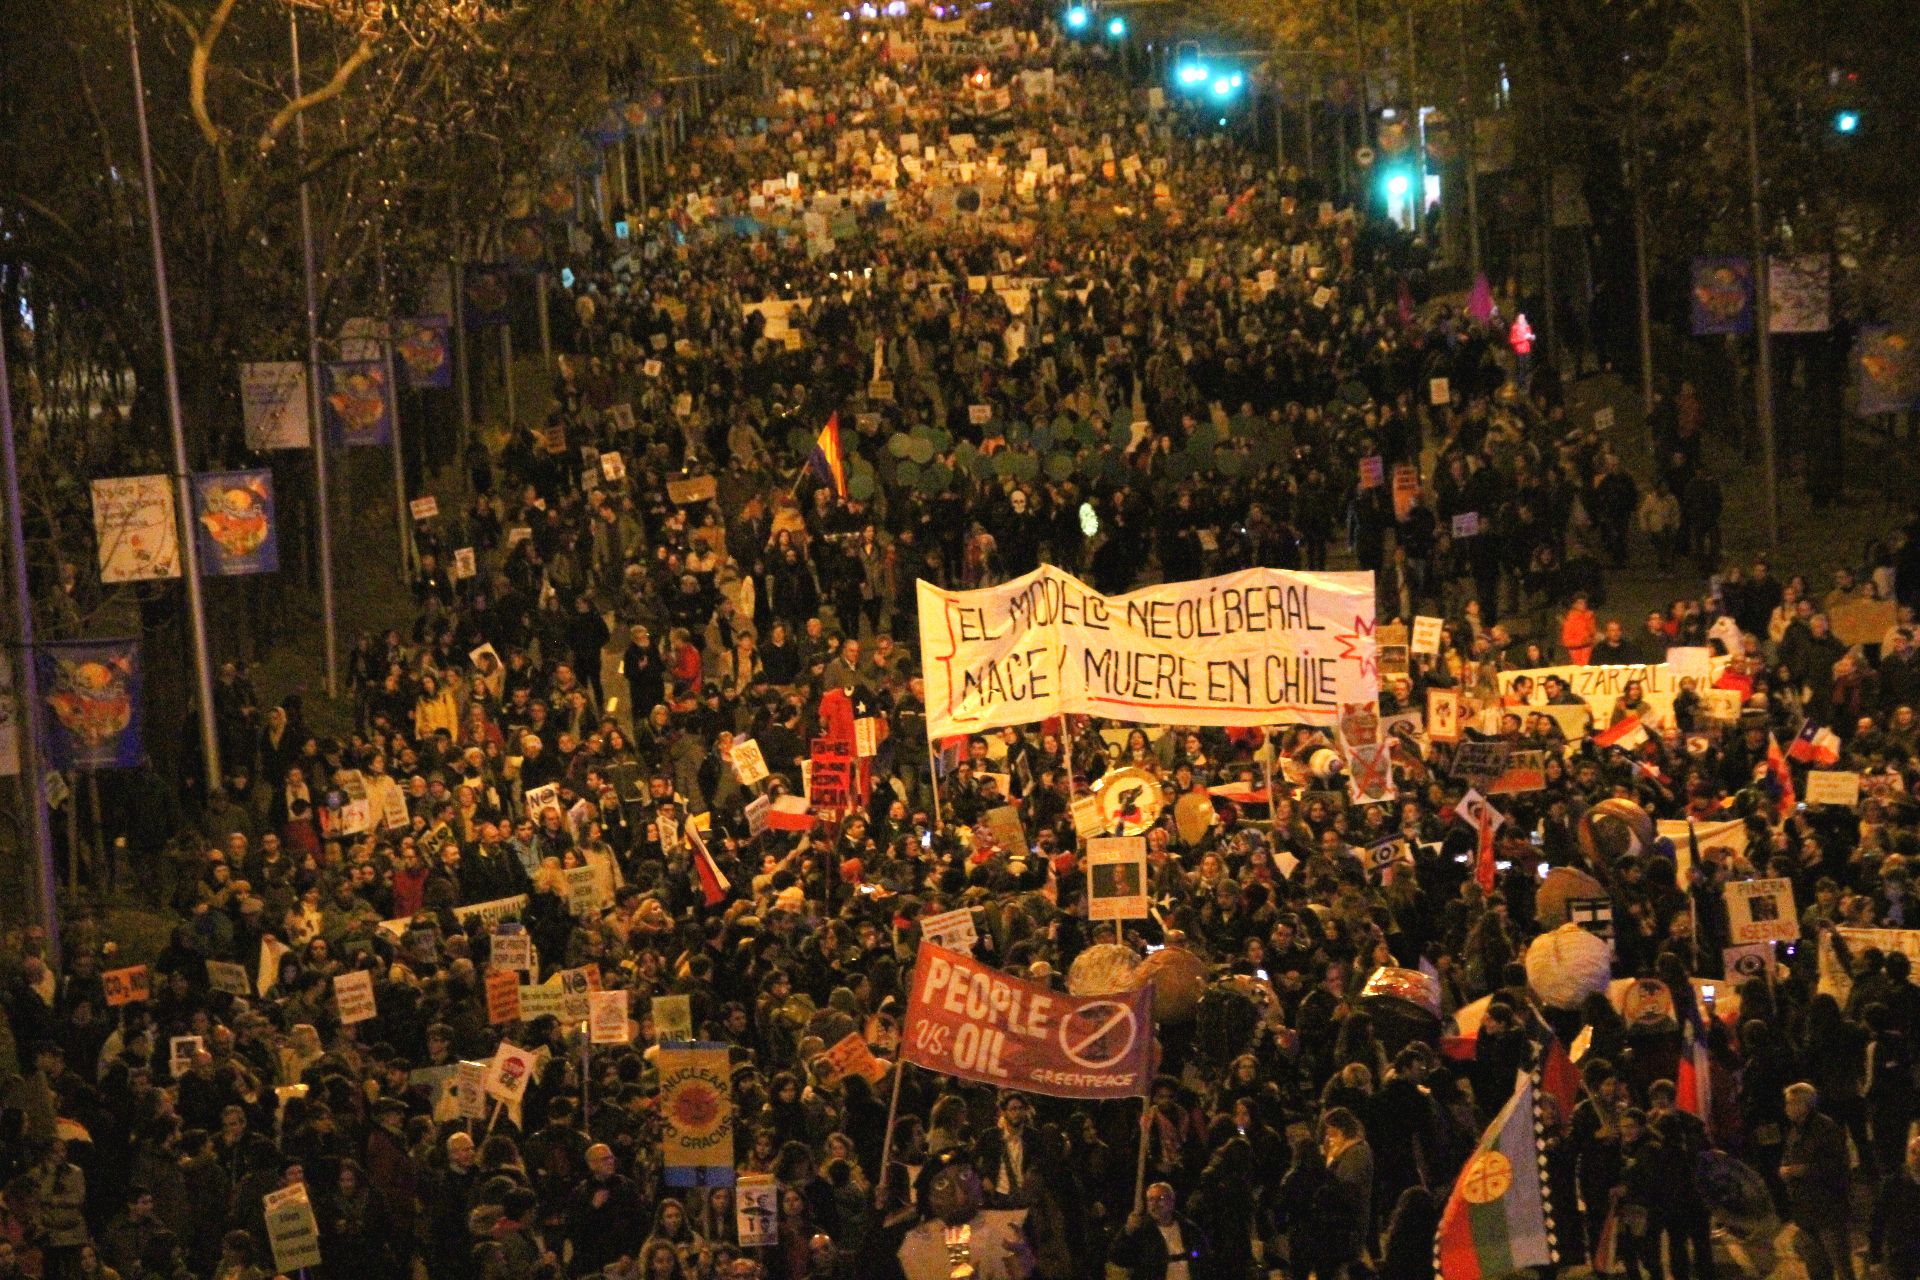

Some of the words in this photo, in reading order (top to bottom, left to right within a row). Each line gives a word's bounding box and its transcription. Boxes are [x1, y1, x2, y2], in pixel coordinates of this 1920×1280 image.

[959, 607, 1001, 642] EL
[1009, 576, 1110, 635] MODELO
[962, 647, 1051, 706] NACE
[1084, 647, 1197, 702] MUERE
[1207, 657, 1251, 705] EN
[921, 956, 1052, 1039] PEOPLE
[953, 1022, 1007, 1078] OIL
[1030, 1068, 1137, 1087] GREENPEACE
